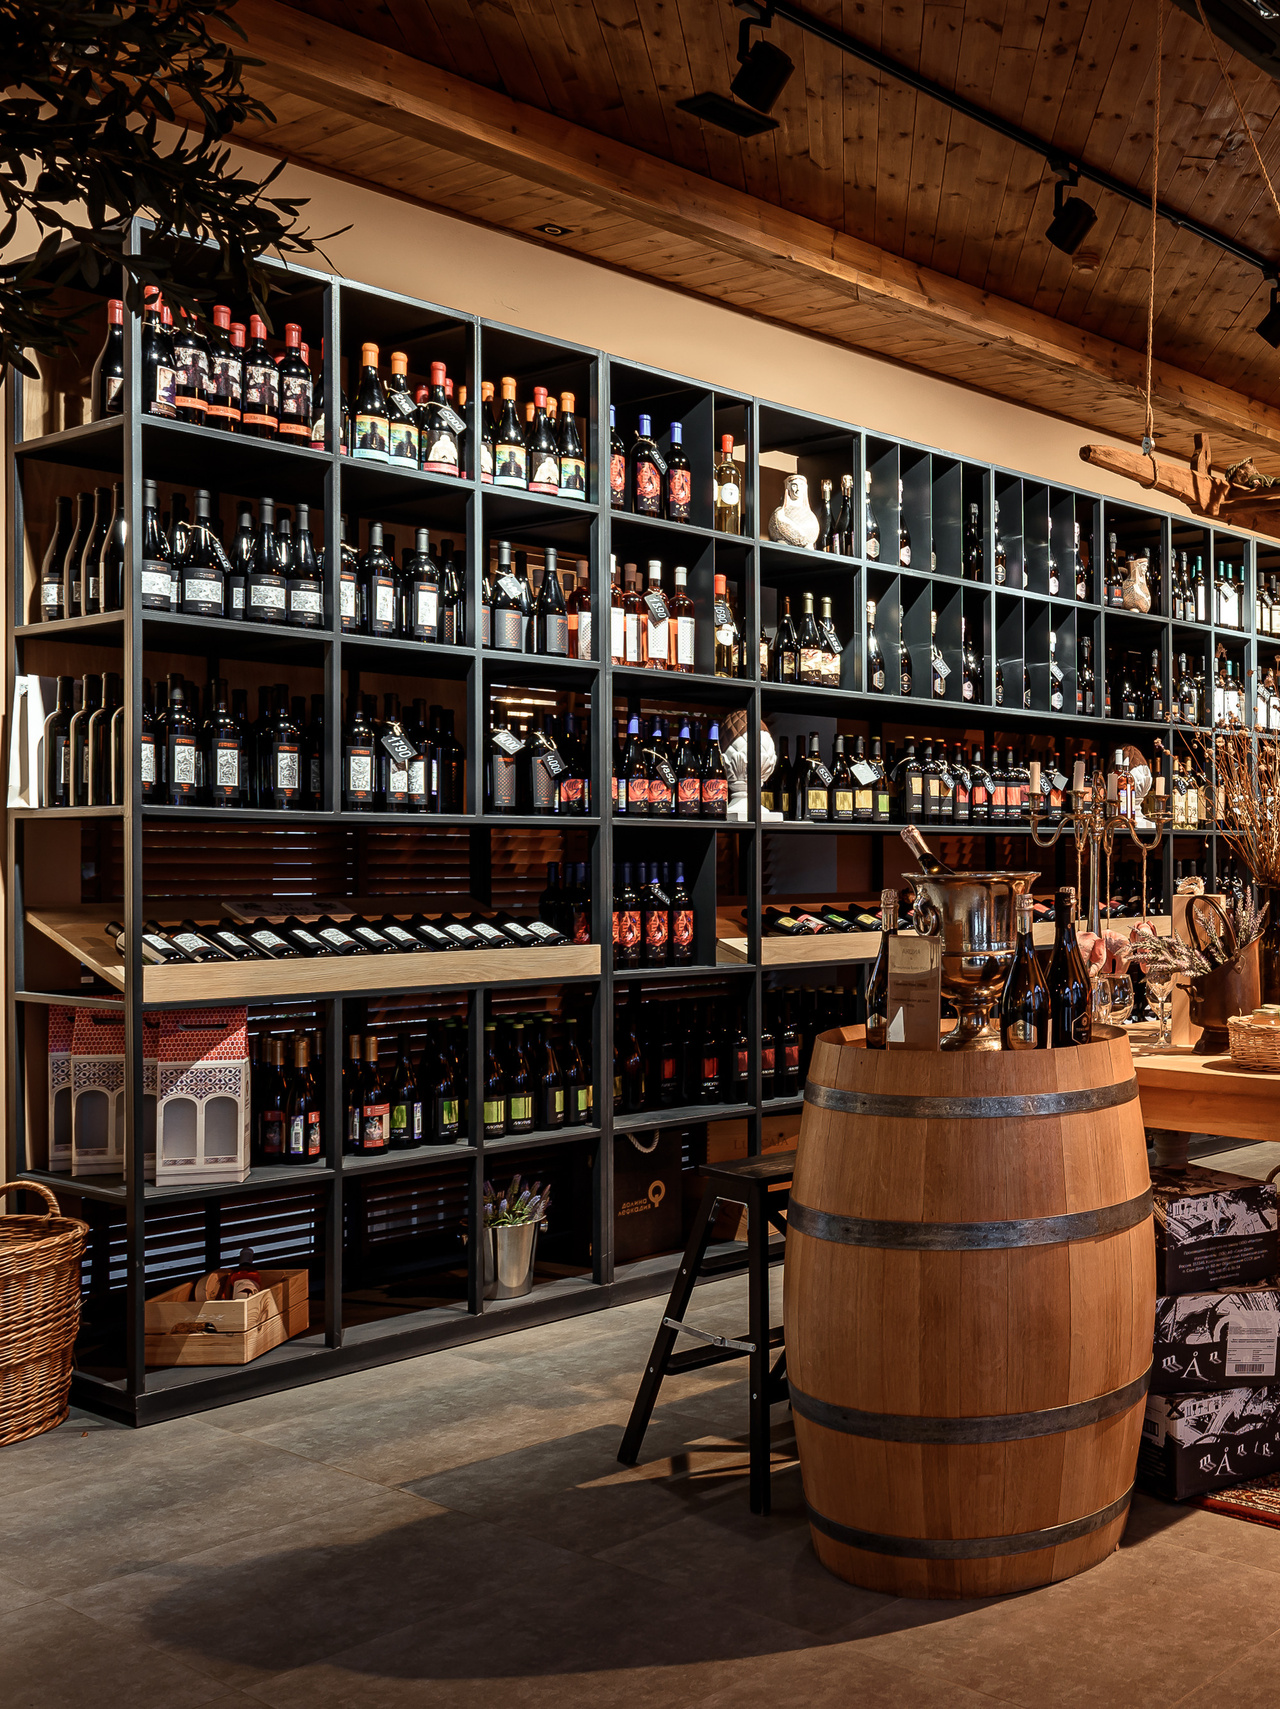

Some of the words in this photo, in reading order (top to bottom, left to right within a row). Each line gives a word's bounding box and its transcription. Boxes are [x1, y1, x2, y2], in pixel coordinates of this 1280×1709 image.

[442, 410, 464, 431] 5000
[651, 595, 667, 618] 1890
[715, 604, 728, 624] 1690
[387, 736, 412, 758] 1790
[499, 733, 520, 750] 4000
[547, 755, 563, 775] 4000
[660, 764, 676, 784] 1850
